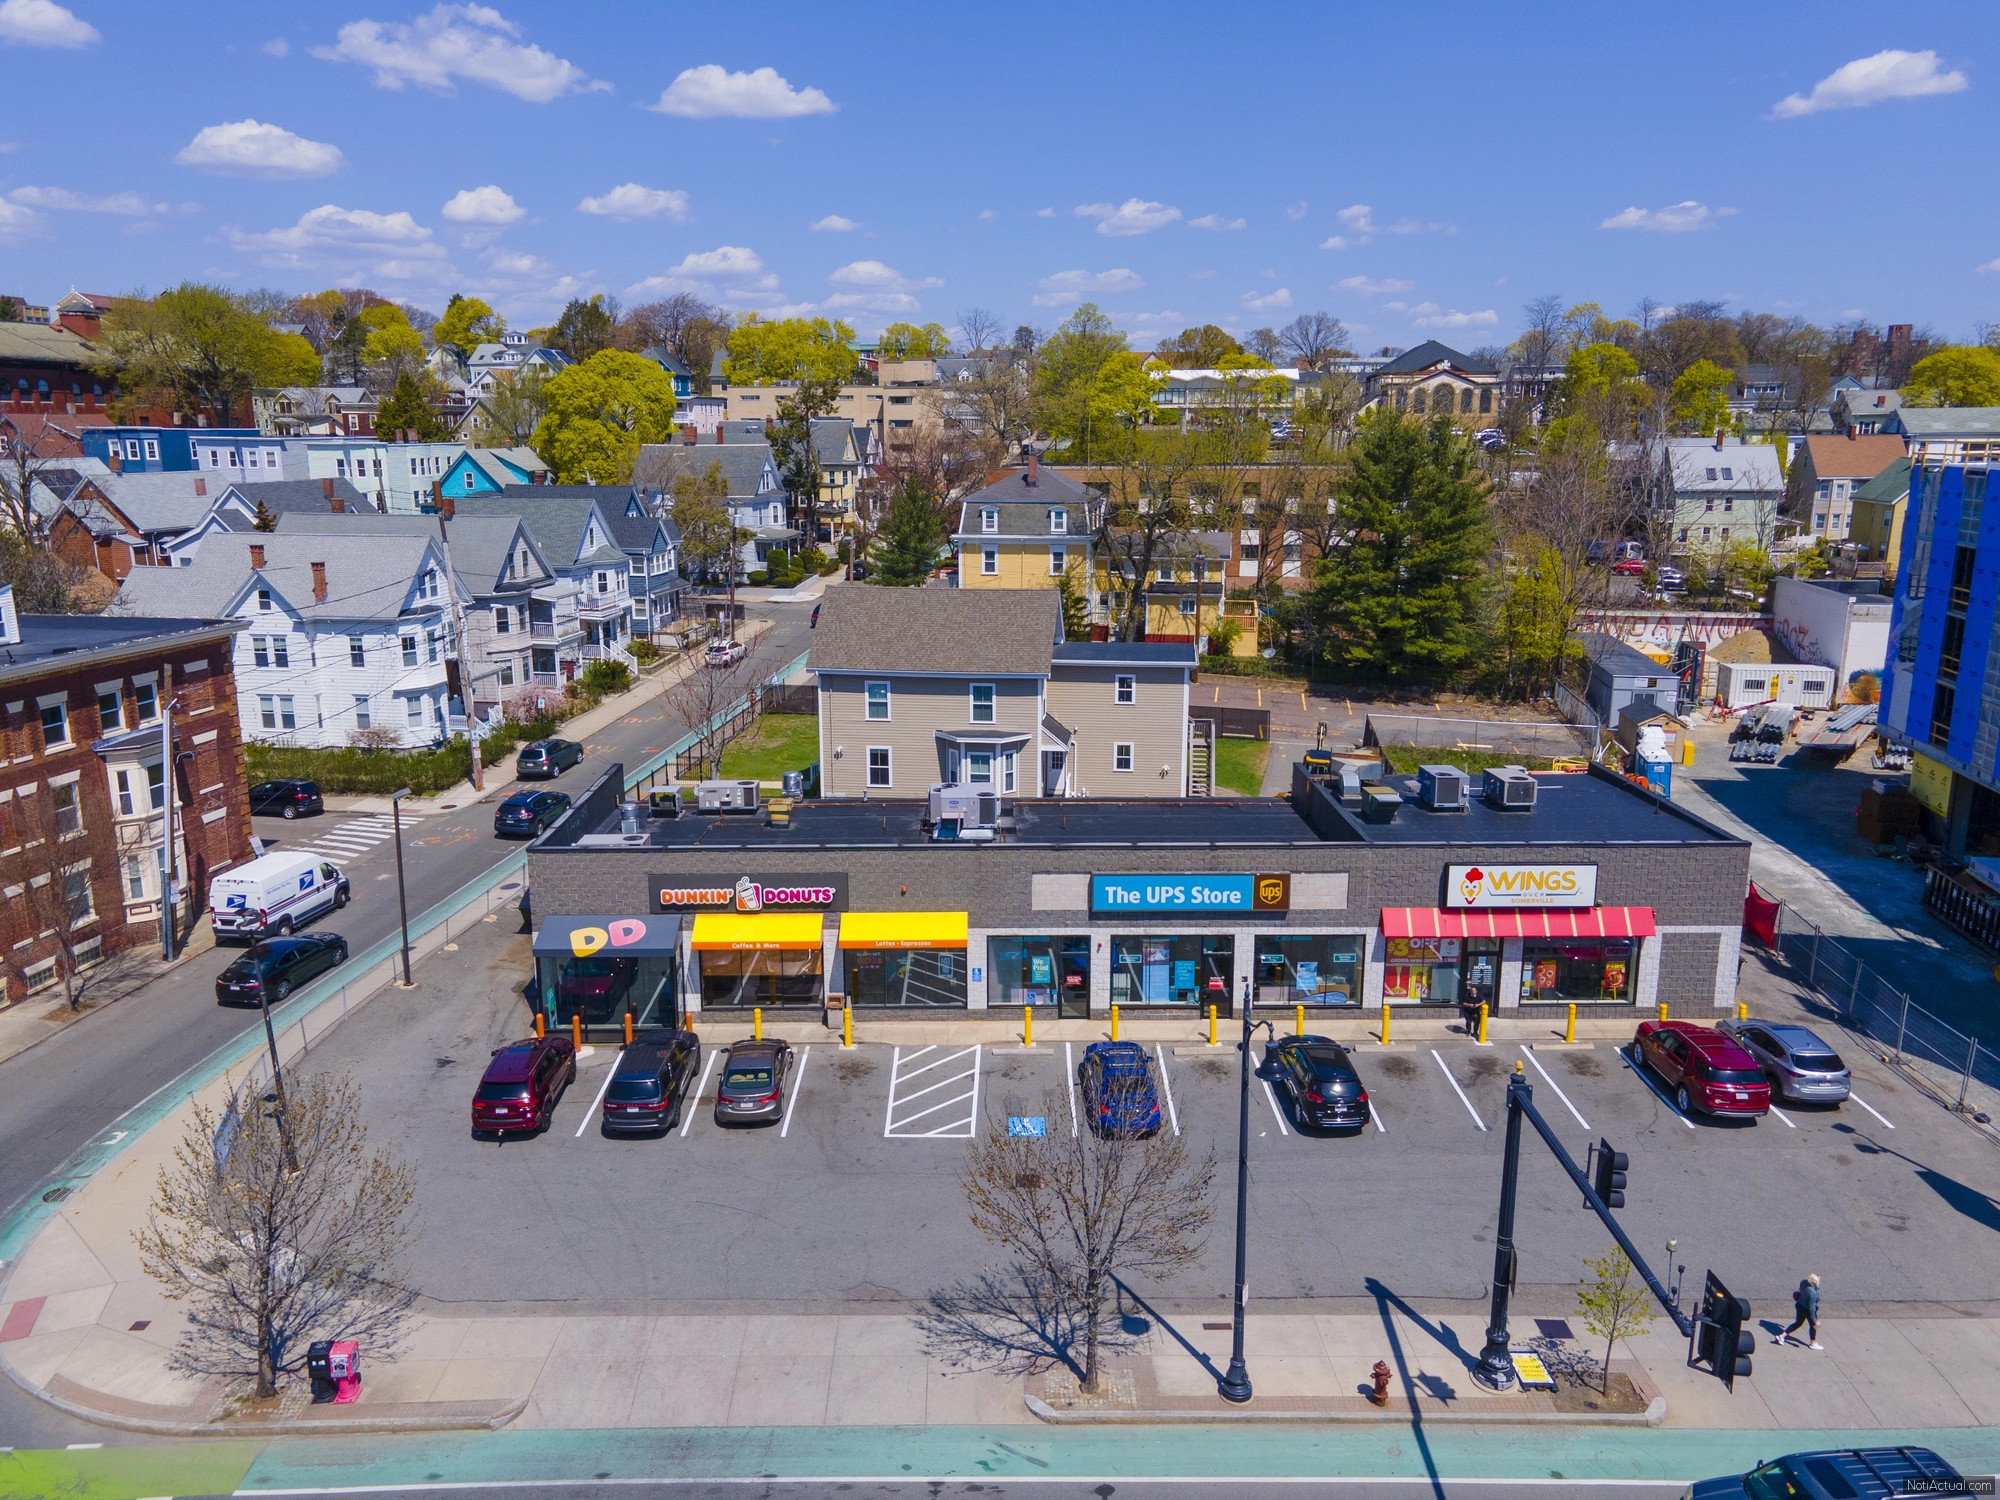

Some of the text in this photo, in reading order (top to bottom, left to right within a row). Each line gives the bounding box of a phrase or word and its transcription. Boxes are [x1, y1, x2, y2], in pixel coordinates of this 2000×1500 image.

[1488, 870, 1576, 891] WINGS
[660, 888, 833, 904] DUNKIN' DONUTS
[1105, 886, 1241, 904] The UPS Store
[1262, 886, 1281, 900] ups
[1409, 937, 1439, 949] OFF
